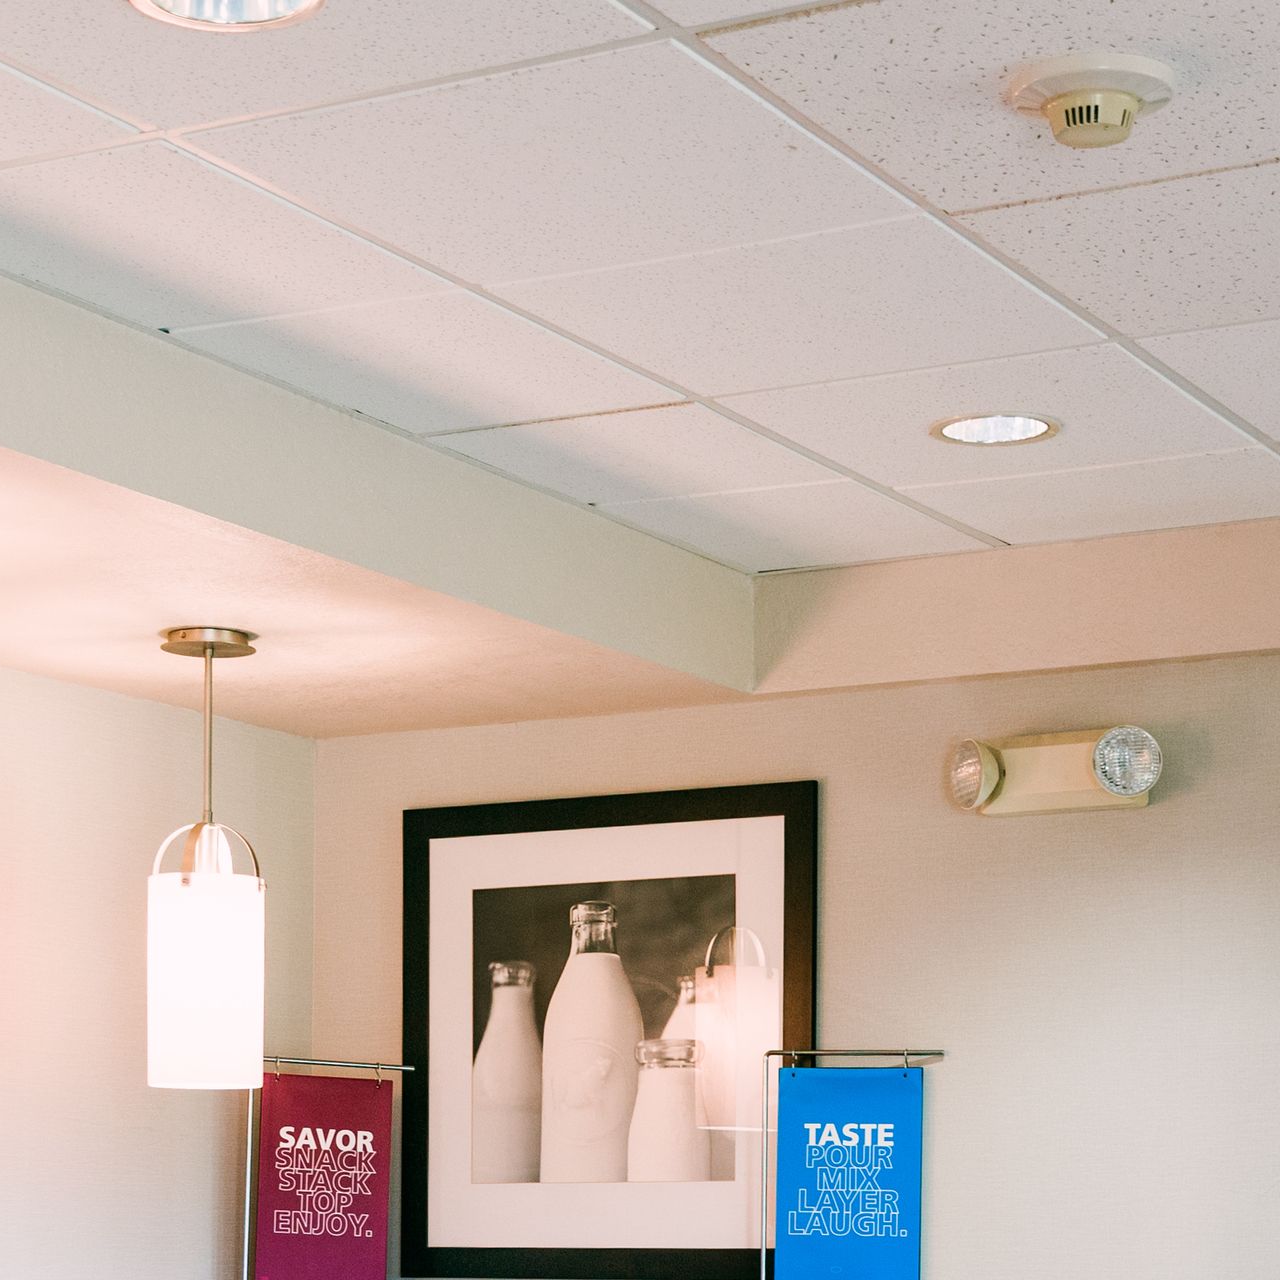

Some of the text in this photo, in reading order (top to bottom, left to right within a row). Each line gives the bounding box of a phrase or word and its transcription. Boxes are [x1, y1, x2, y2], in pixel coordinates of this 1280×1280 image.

[279, 1126, 374, 1153] SAVOR
[804, 1123, 894, 1147] TASTE
[275, 1146, 376, 1174] SNACK
[806, 1144, 893, 1169] POUR
[279, 1168, 372, 1195] STACK
[817, 1166, 881, 1191] MIX
[296, 1190, 353, 1214] TOP
[798, 1189, 899, 1214] LAYER
[273, 1210, 373, 1238] ENJOY.
[788, 1211, 908, 1237] LAUGH.
